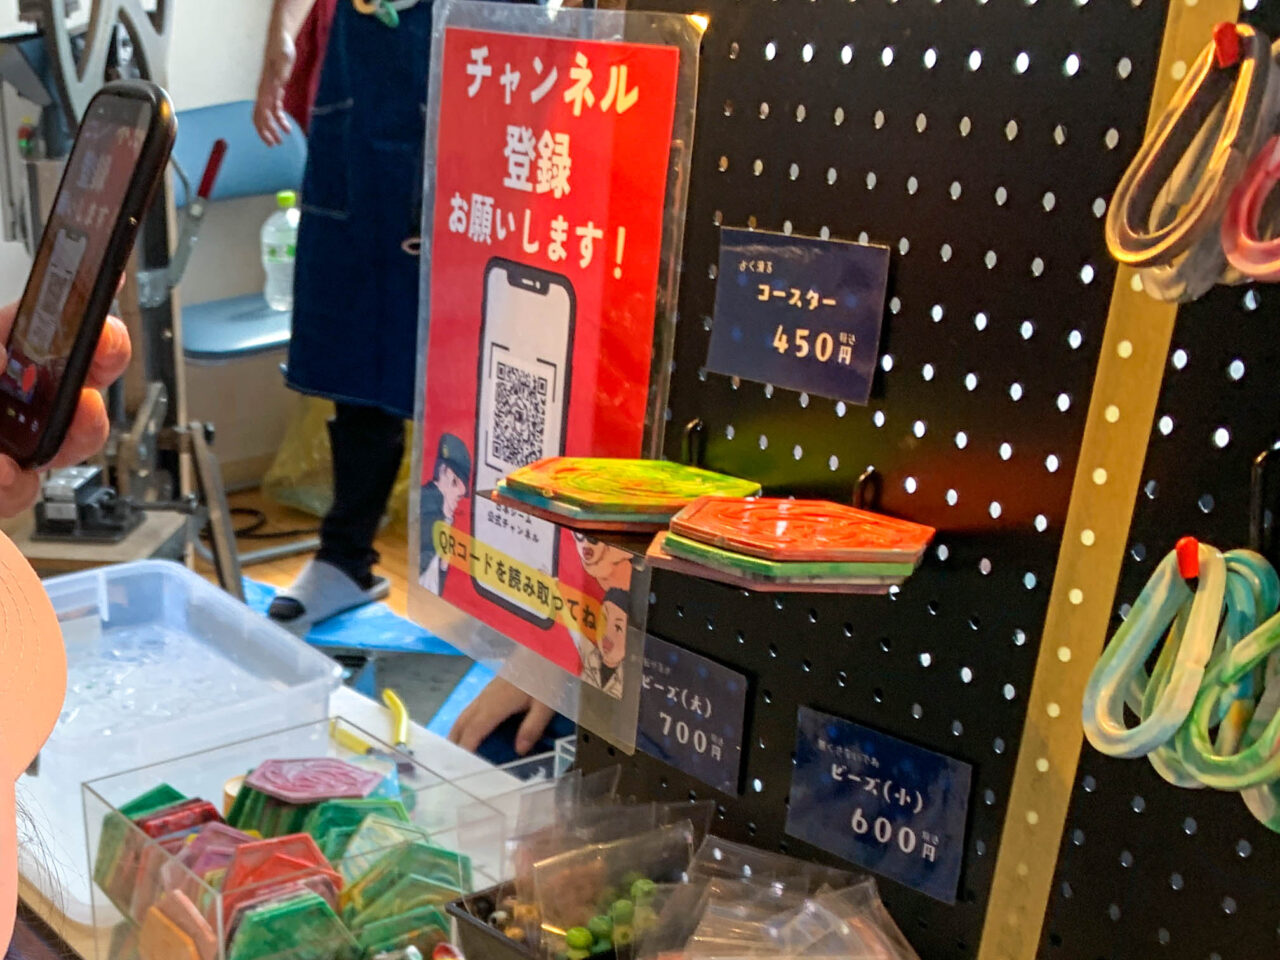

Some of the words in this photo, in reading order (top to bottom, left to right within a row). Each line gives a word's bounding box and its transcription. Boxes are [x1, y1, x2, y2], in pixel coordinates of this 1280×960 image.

[466, 45, 639, 116] チャンネル
[503, 124, 571, 199] 登録
[758, 284, 837, 310] コースター
[439, 530, 597, 630] QRコードを読み取ってね
